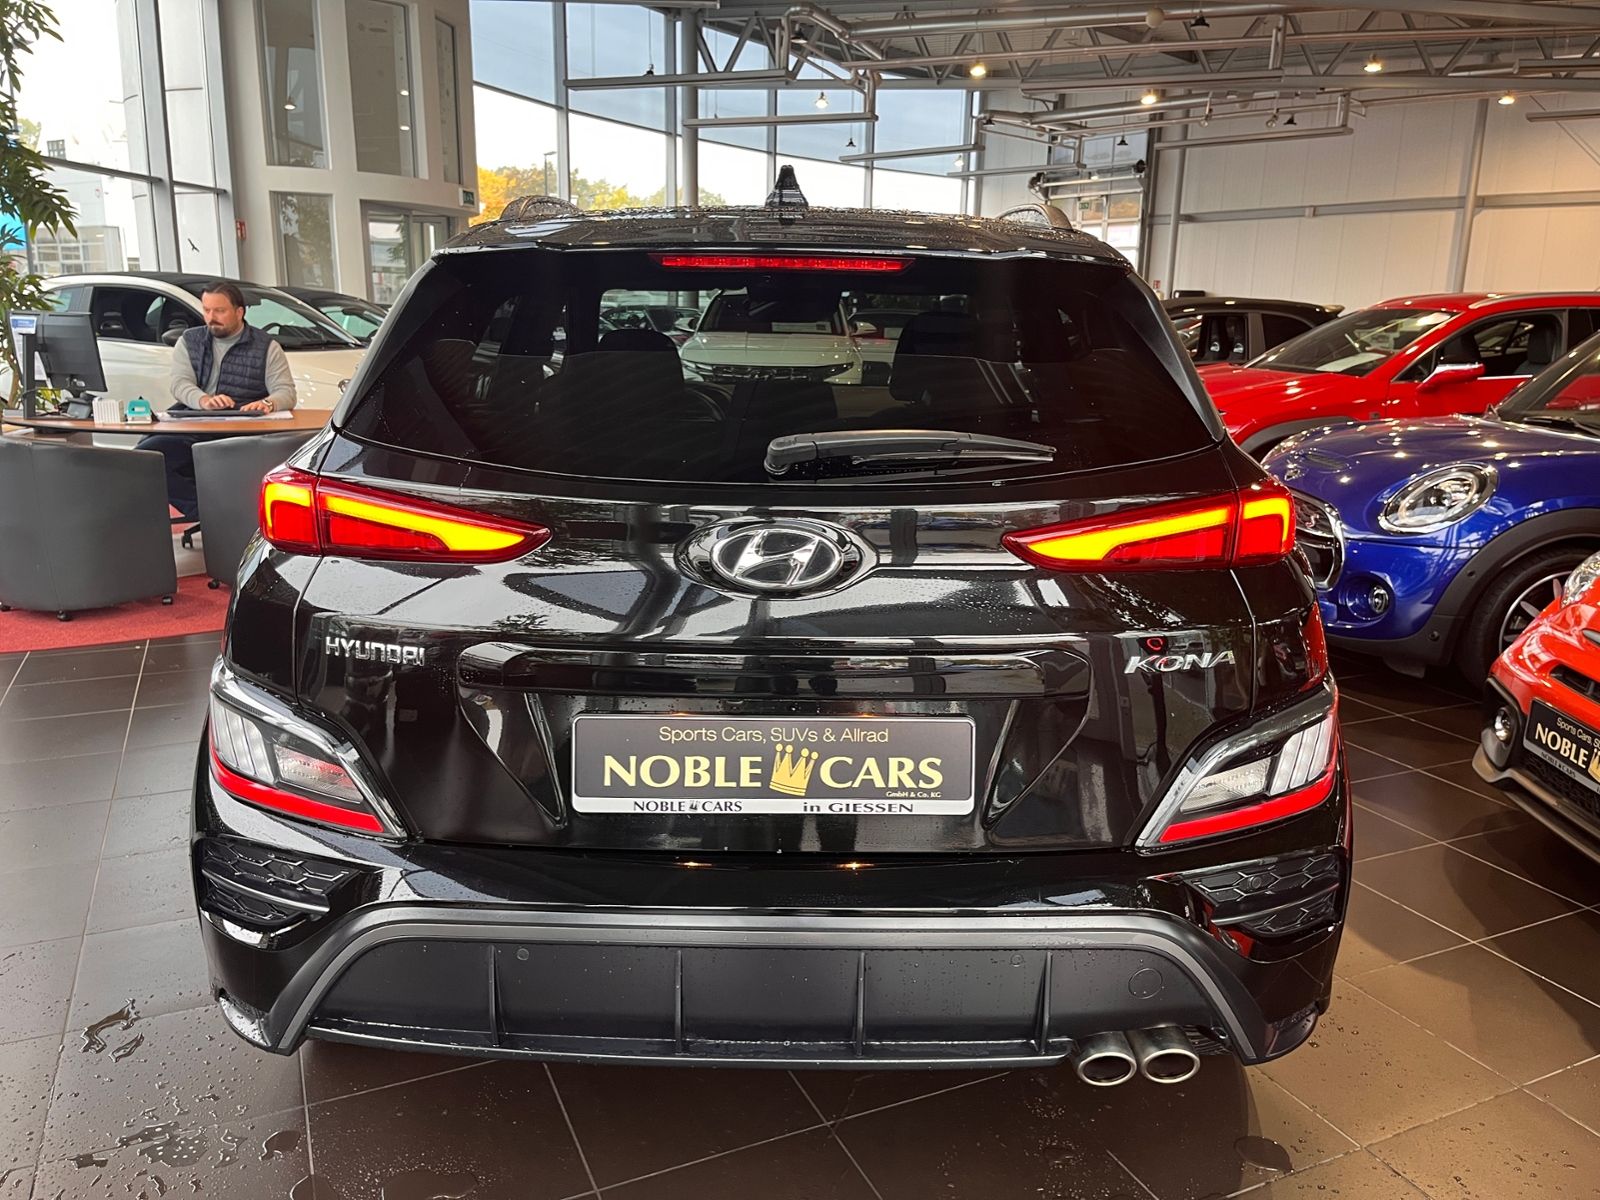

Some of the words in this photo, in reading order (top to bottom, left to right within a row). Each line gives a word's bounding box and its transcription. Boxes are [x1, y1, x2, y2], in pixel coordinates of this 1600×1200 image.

[325, 636, 426, 667] HYUNDAI
[1123, 650, 1236, 675] KONA
[659, 726, 718, 744] Sports
[721, 726, 767, 744] Cars,
[770, 727, 819, 743] SUVs
[822, 727, 837, 743] &
[840, 727, 890, 743] Allrad
[1556, 717, 1577, 736] Sports
[1534, 722, 1590, 769] NOBLE
[603, 755, 763, 788] NOBLE
[819, 755, 944, 789] CARS
[886, 790, 909, 798] GmbH
[633, 800, 686, 812] NOBLE
[702, 800, 743, 812] CARS
[803, 801, 821, 813] in
[828, 802, 914, 813] GIESSEN
